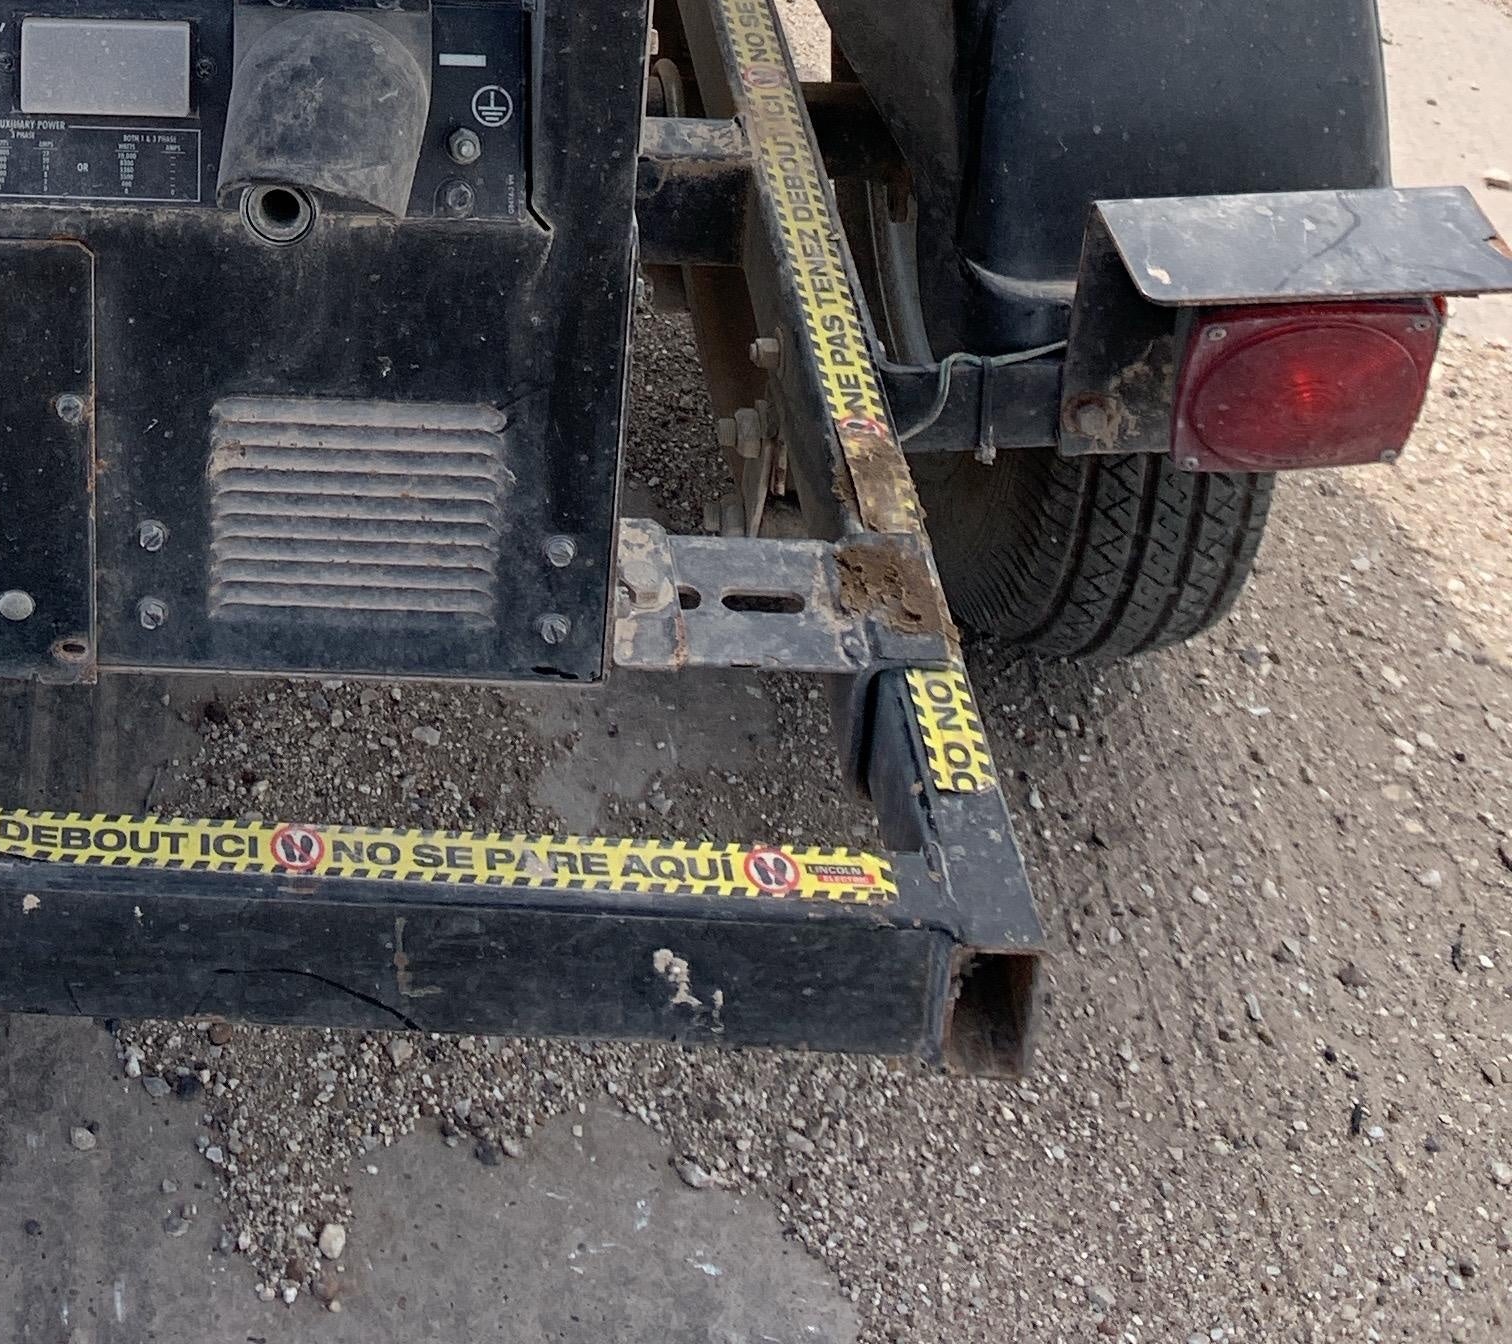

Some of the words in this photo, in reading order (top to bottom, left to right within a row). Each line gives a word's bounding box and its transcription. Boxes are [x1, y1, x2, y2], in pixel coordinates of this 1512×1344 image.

[739, 2, 760, 29] SE
[745, 32, 770, 62] NO
[37, 120, 66, 130] POWER
[77, 163, 88, 172] OR
[798, 228, 838, 308] TENEZ
[821, 314, 856, 367] PAS
[840, 372, 868, 412] NE
[925, 679, 963, 731] NO
[199, 831, 260, 860] ICI
[331, 839, 402, 866] NO
[412, 843, 476, 872] SE
[486, 847, 610, 878] PARE
[619, 852, 735, 884] AQUÍ
[807, 865, 862, 876] LINCOLN
